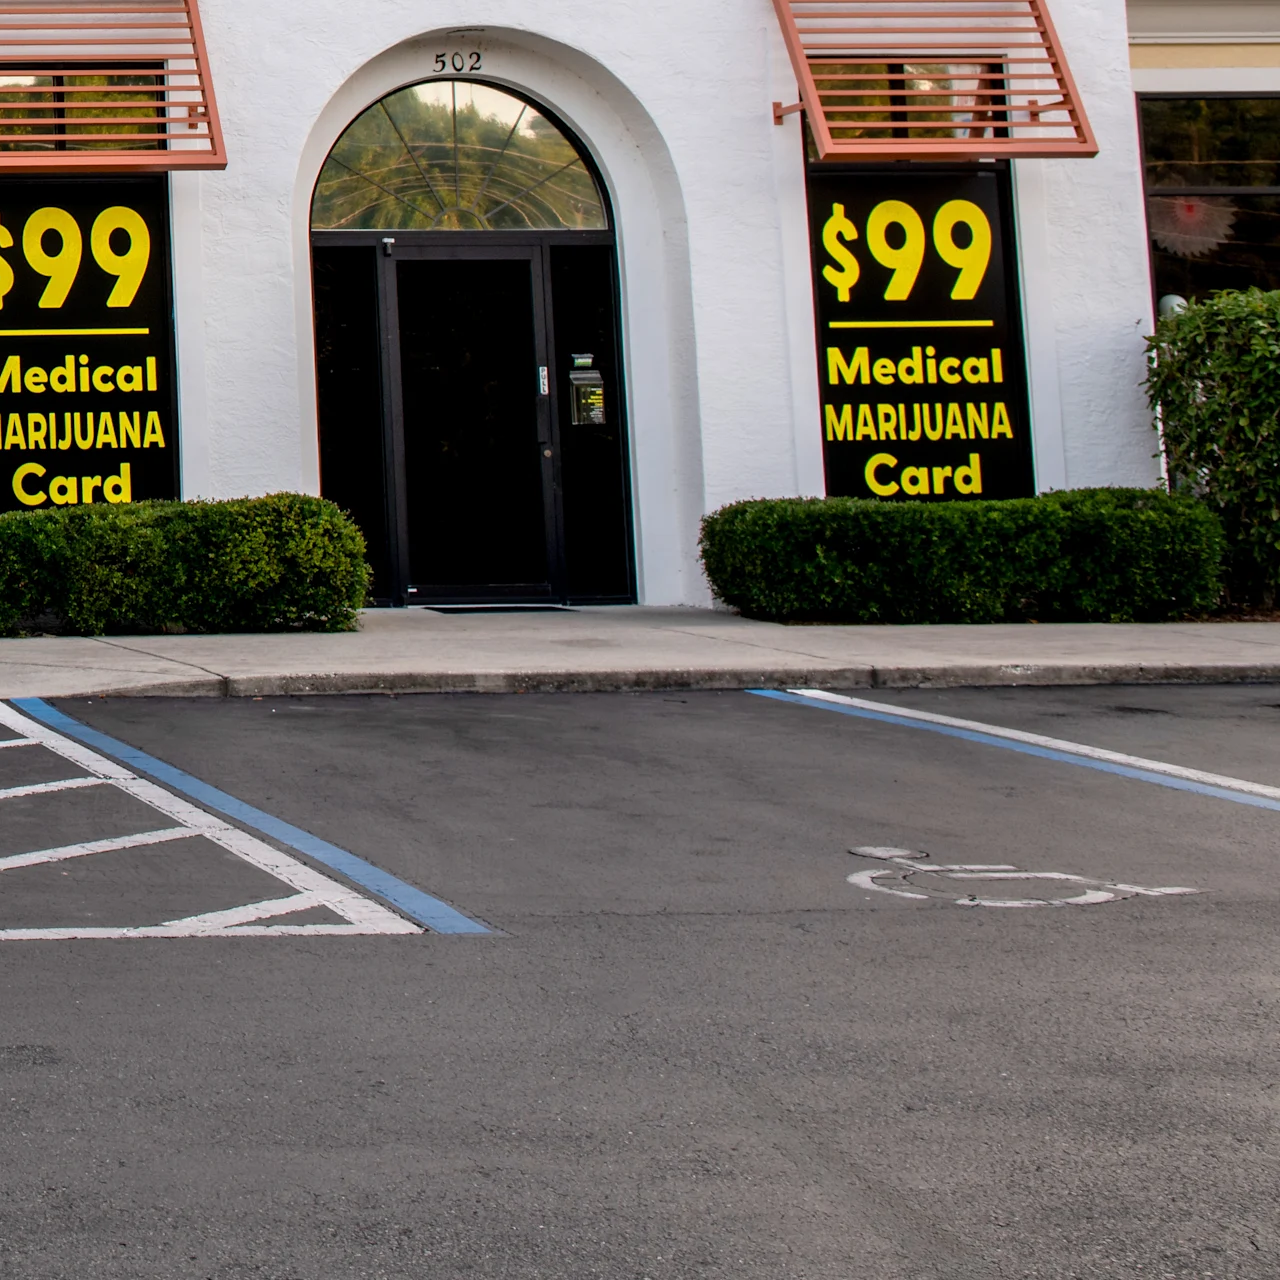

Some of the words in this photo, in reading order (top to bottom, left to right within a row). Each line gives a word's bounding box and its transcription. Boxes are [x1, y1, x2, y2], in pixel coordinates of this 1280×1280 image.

[432, 51, 482, 73] 502
[822, 199, 993, 303] $99
[826, 345, 1004, 385] Medical
[824, 402, 1014, 442] MARIJUANA
[12, 462, 133, 506] Card
[864, 453, 983, 497] Card
